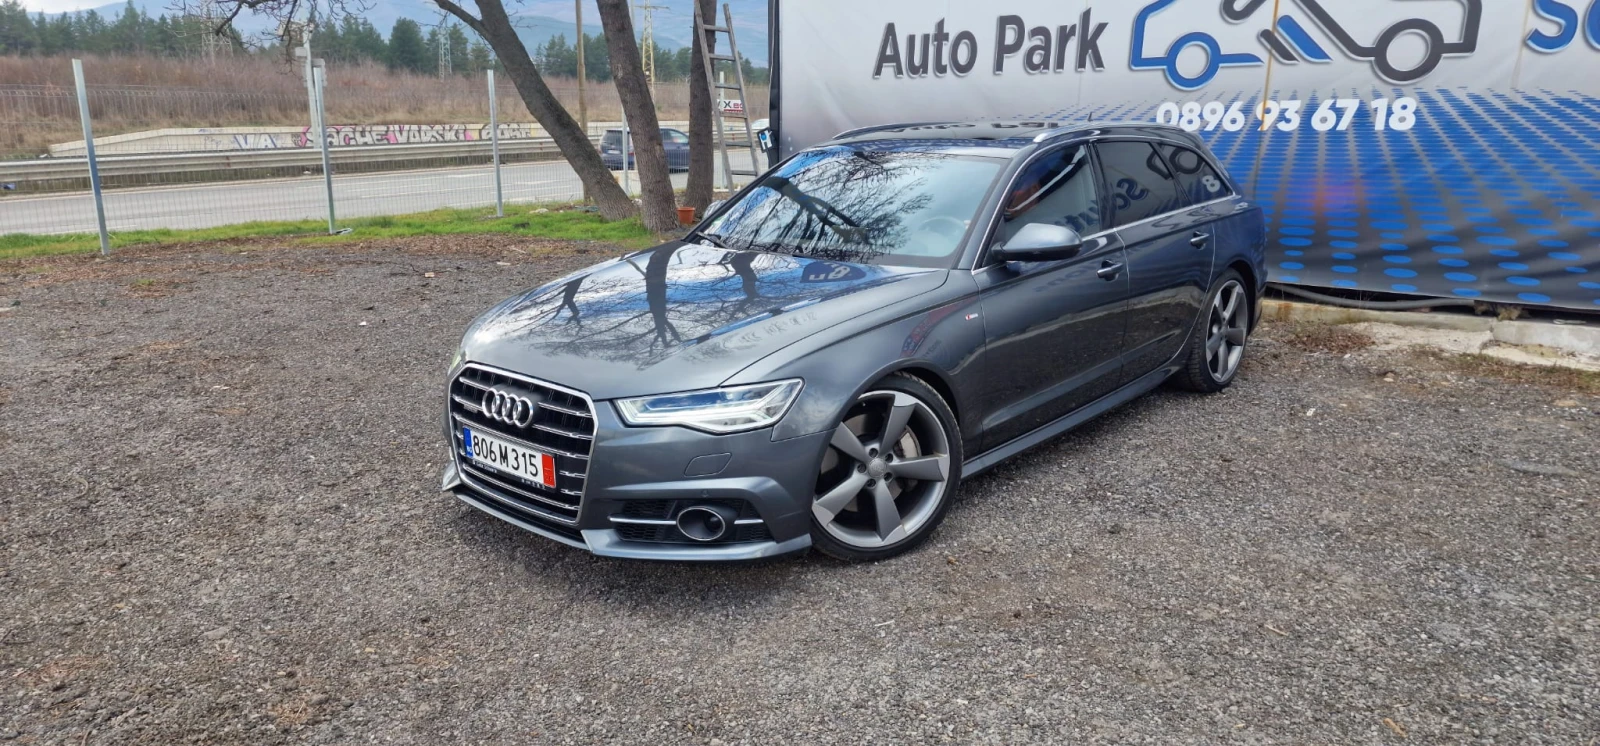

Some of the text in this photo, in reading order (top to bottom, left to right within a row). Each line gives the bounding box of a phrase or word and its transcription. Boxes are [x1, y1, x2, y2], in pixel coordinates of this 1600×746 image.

[872, 7, 1109, 79] Auto Park
[1524, 0, 1600, 54] S
[1156, 97, 1417, 132] 0896 93 67 18
